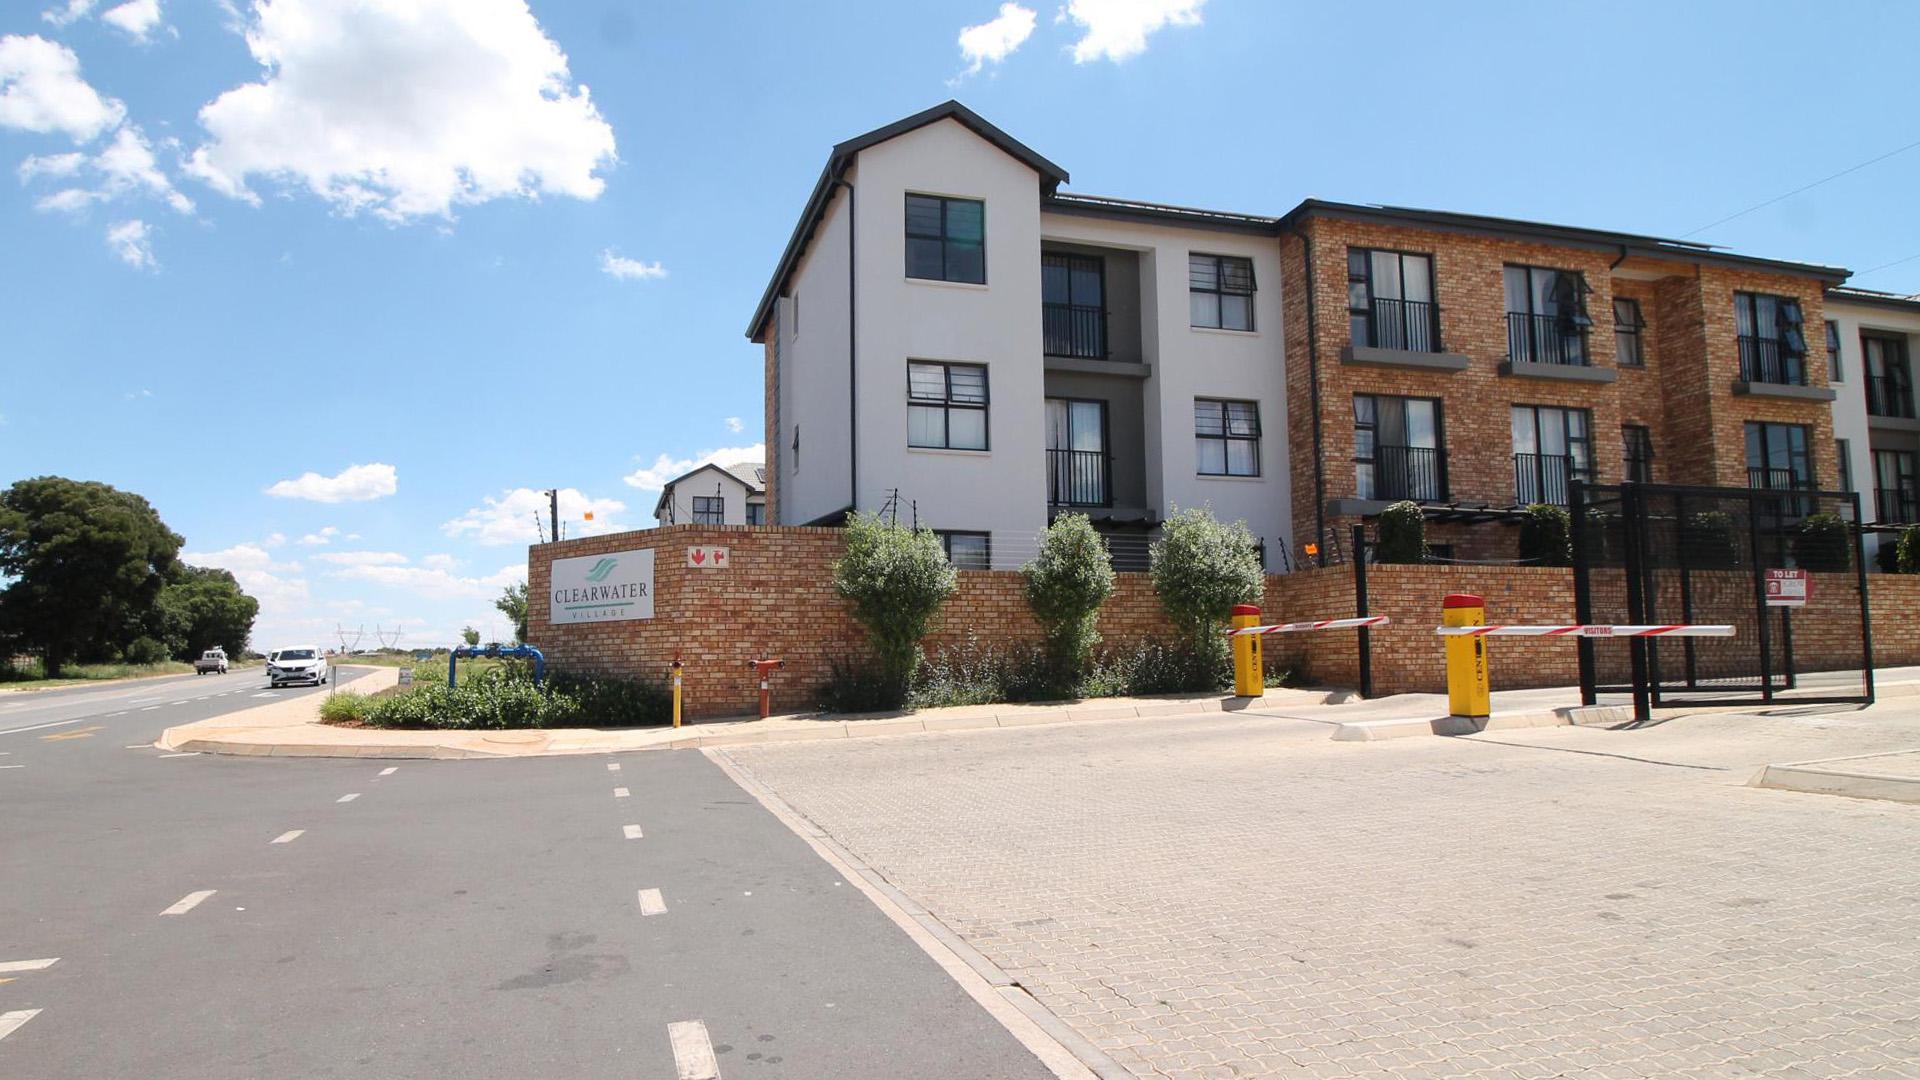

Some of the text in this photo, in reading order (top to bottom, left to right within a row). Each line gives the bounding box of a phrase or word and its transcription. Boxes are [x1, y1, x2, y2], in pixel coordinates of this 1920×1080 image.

[1773, 570, 1799, 579] TO LET
[555, 582, 648, 604] CLEARWATER
[572, 608, 625, 619] VILLAGE
